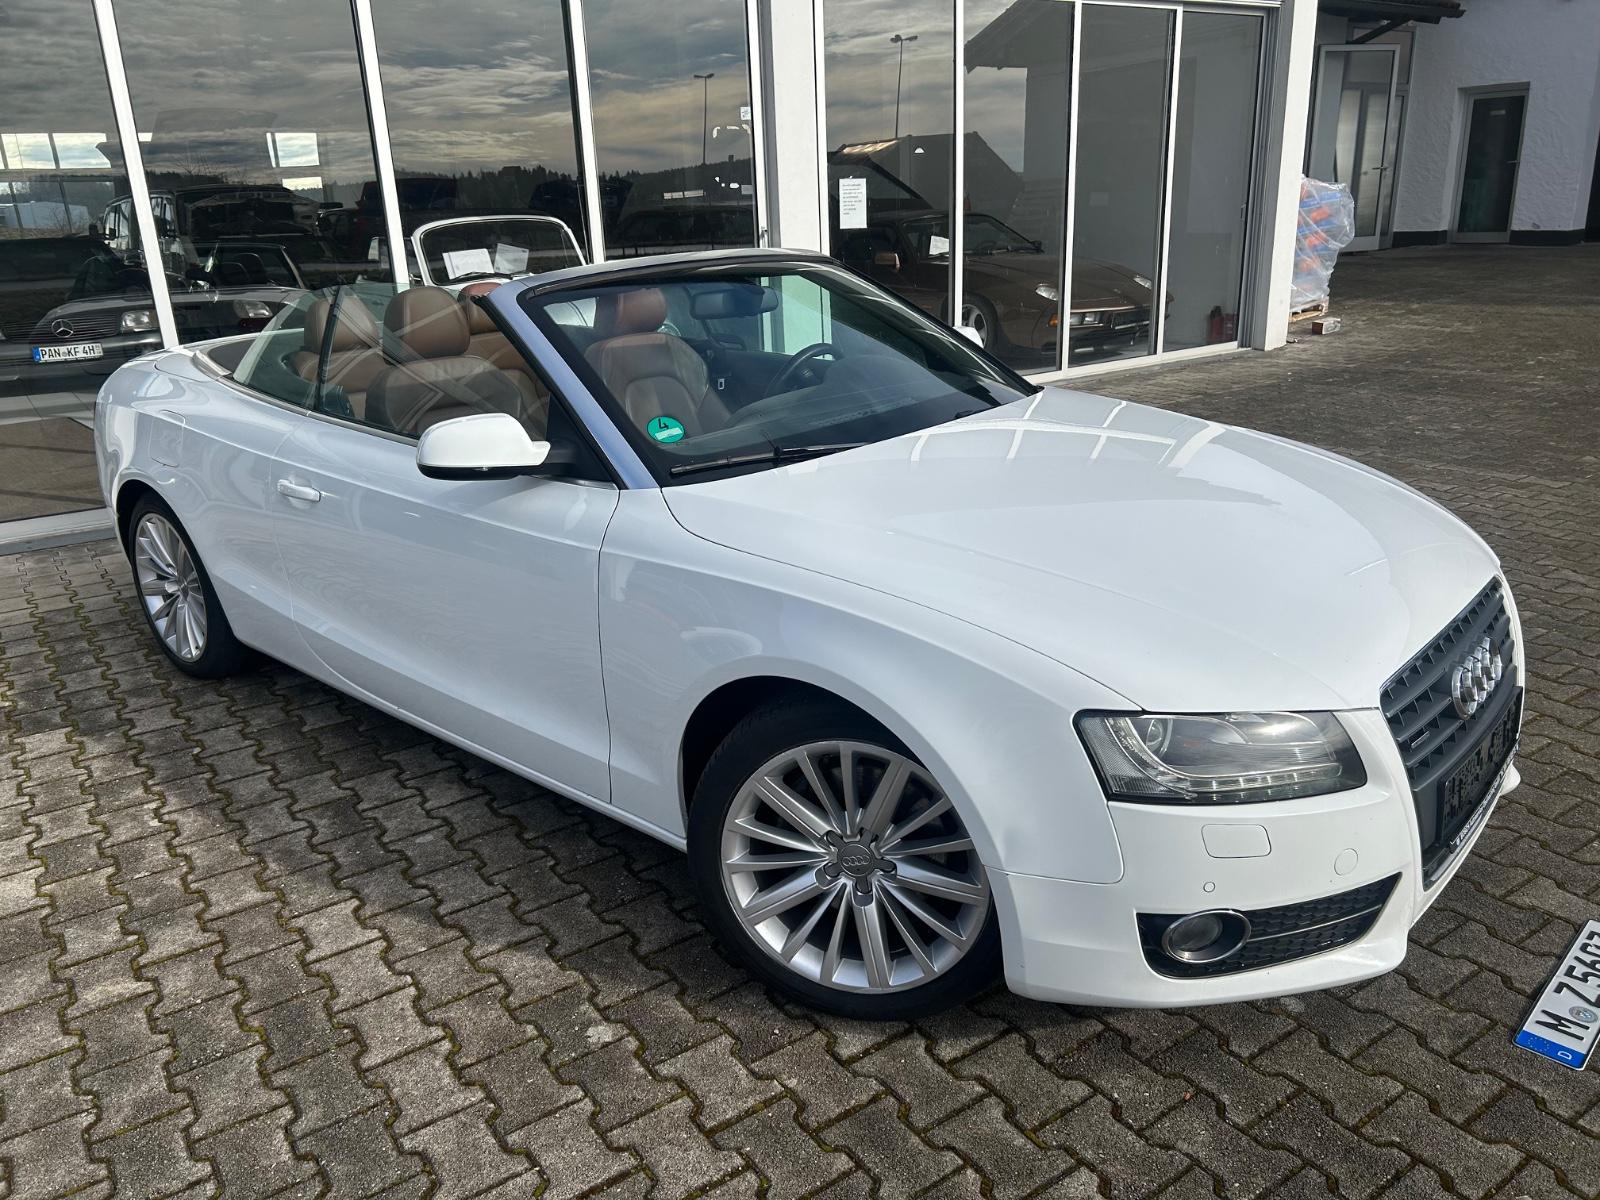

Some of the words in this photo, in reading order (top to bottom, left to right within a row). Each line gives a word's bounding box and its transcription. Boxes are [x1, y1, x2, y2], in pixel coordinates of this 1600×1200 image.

[40, 348, 61, 359] PAN
[67, 346, 80, 357] KF
[83, 345, 96, 355] 4H
[658, 418, 669, 430] 4
[1535, 1009, 1591, 1042] M
[1557, 1050, 1573, 1060] D
